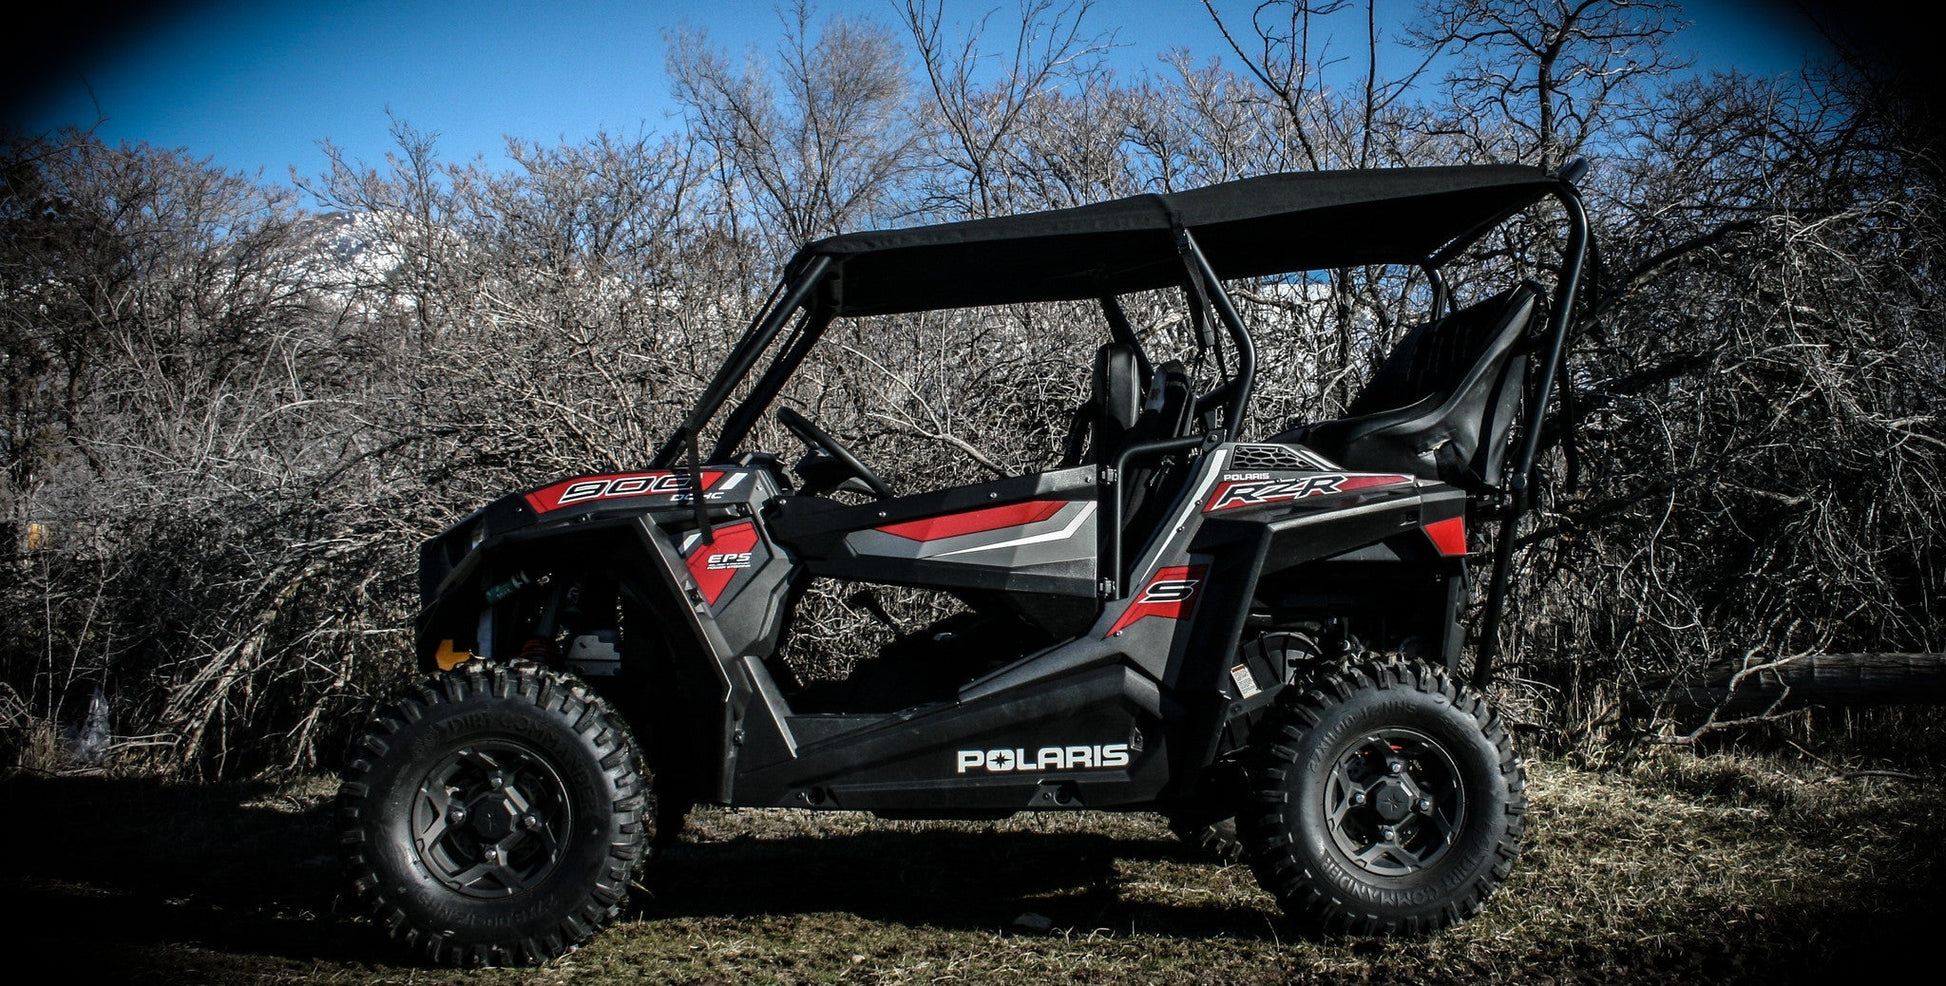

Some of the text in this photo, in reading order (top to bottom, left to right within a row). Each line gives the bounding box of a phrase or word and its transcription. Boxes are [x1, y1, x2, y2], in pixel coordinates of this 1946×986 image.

[557, 473, 703, 504] 900
[1223, 472, 1270, 481] POLARIS
[1210, 474, 1349, 511] RZR
[707, 552, 752, 564] EPS
[1138, 579, 1200, 603] S
[957, 743, 1130, 773] POLARIS
